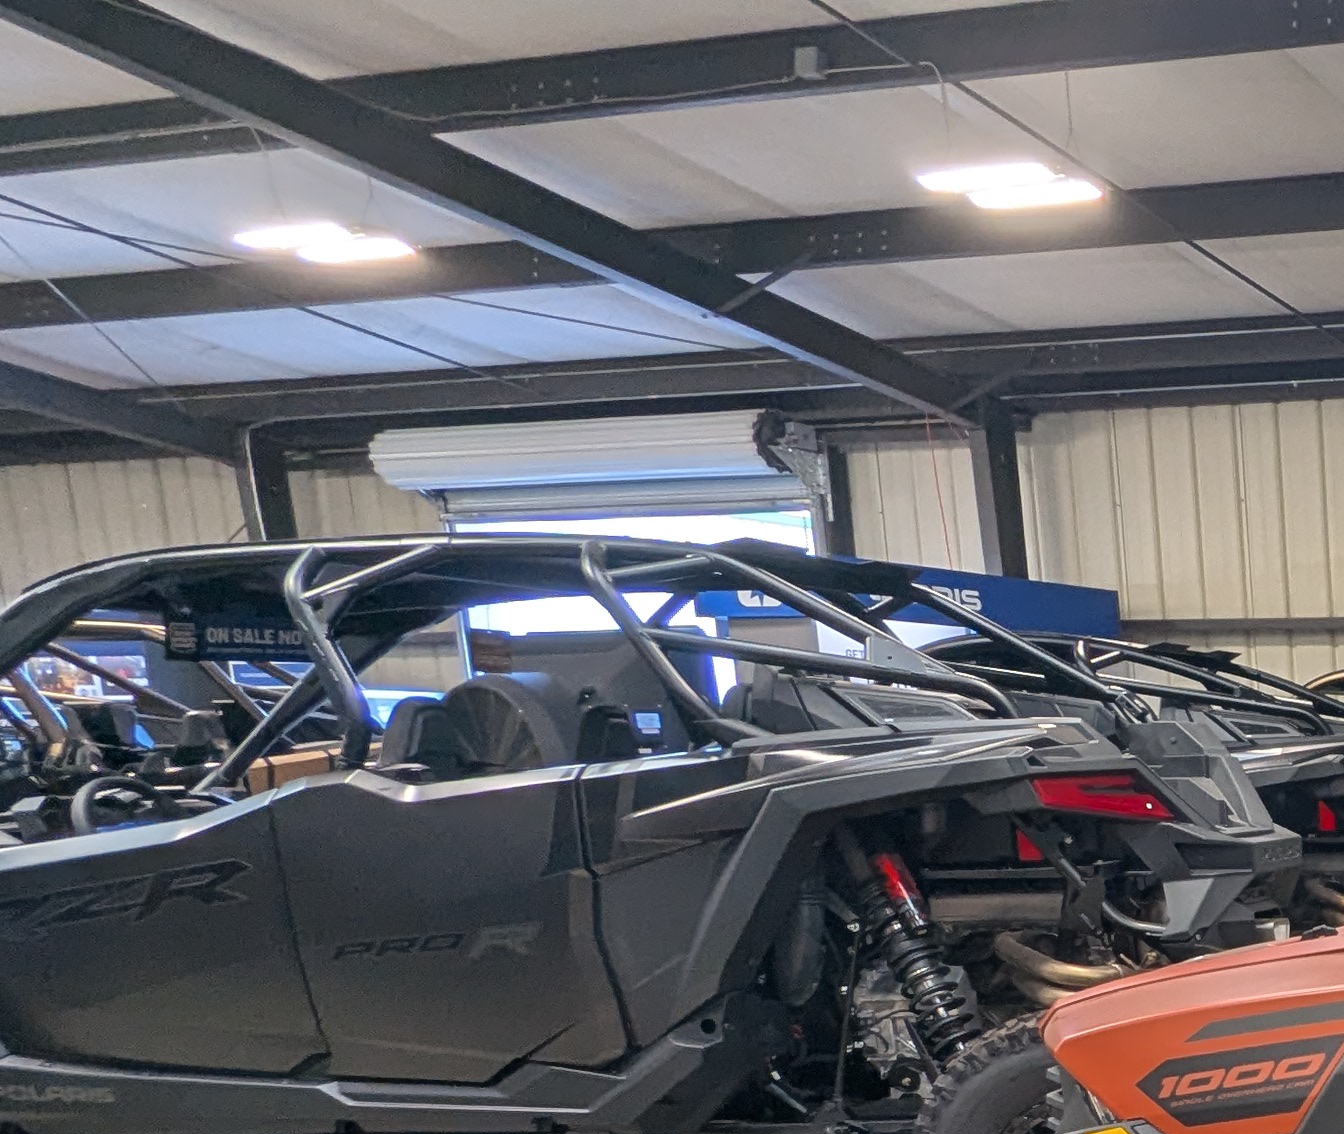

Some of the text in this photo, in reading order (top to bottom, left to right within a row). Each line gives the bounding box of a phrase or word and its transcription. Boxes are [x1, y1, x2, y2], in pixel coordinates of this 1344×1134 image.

[206, 627, 229, 643] ON
[233, 628, 273, 645] SALE
[280, 628, 302, 646] NO
[0, 858, 253, 940] ZR
[332, 920, 544, 961] PRO R
[0, 1084, 116, 1104] OLARIS
[1158, 1053, 1326, 1099] 1000
